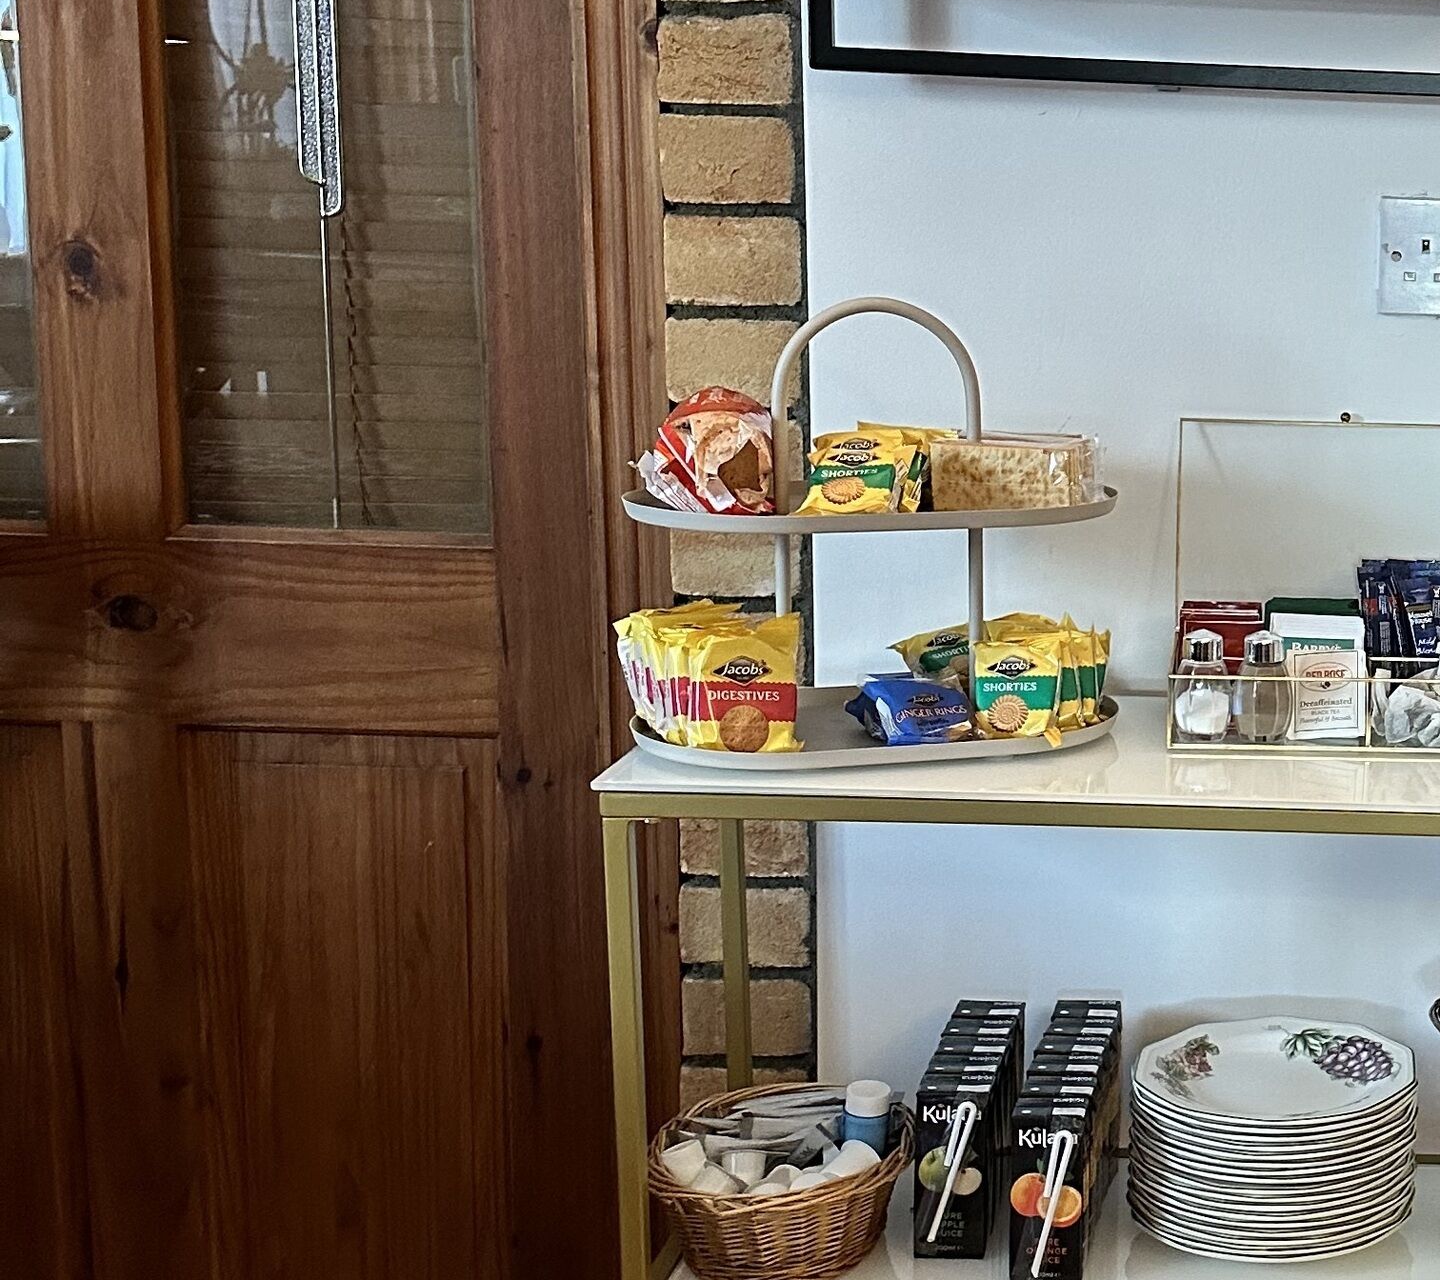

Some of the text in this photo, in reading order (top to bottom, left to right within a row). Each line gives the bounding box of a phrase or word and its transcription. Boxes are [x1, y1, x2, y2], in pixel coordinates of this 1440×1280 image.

[931, 644, 969, 659] SHORTI
[720, 661, 764, 676] Jacobs
[994, 659, 1031, 672] Jacobs
[982, 681, 1037, 692] SHORTIES
[708, 689, 780, 701] DIGESTIVES
[1299, 697, 1353, 708] Decaffeinated
[895, 707, 933, 724] GINGER
[934, 704, 968, 718] RINGS
[922, 1104, 982, 1124] Kulaa
[1018, 1127, 1078, 1149] Kulaa
[943, 1211, 962, 1220] URE
[941, 1220, 965, 1229] PPLE
[1025, 1247, 1068, 1255] ONGE
